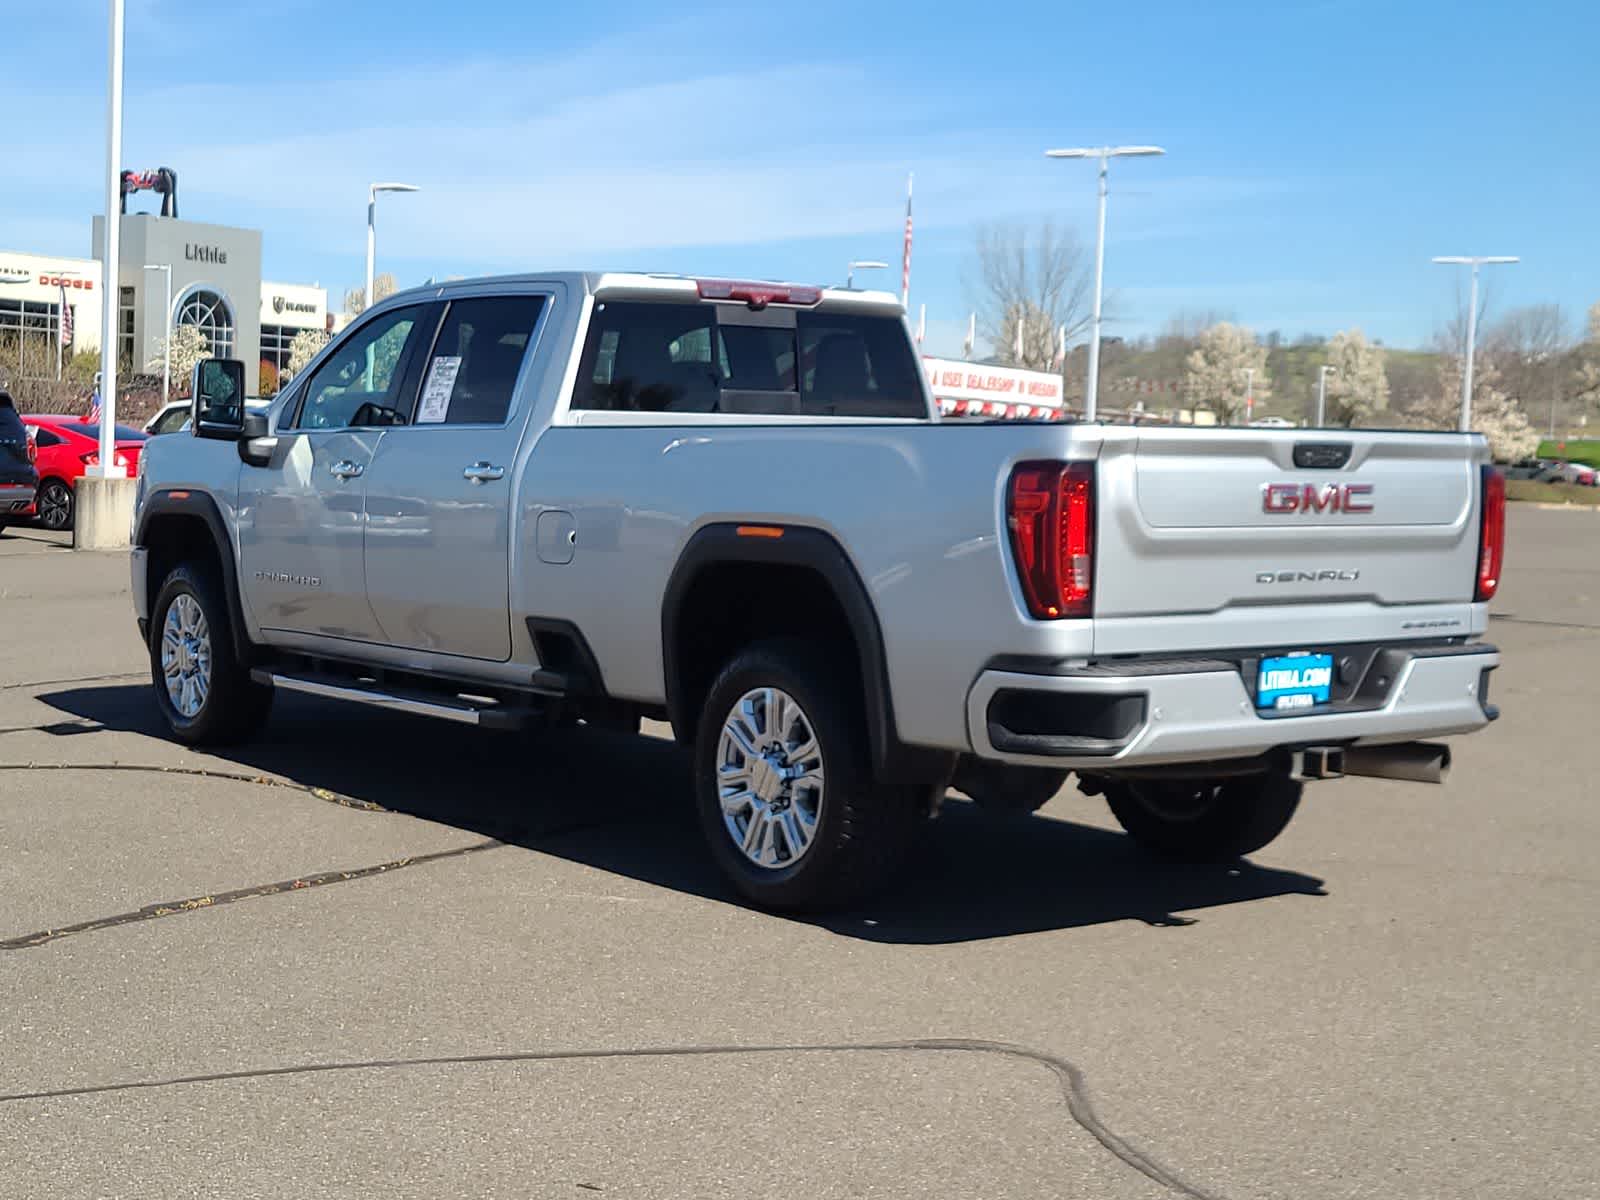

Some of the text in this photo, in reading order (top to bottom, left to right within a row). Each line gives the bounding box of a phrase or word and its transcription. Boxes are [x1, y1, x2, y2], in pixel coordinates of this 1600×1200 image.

[185, 243, 227, 264] Lithia
[39, 276, 93, 290] DODGE
[1263, 483, 1374, 514] GMC
[1256, 570, 1360, 584] DENALI
